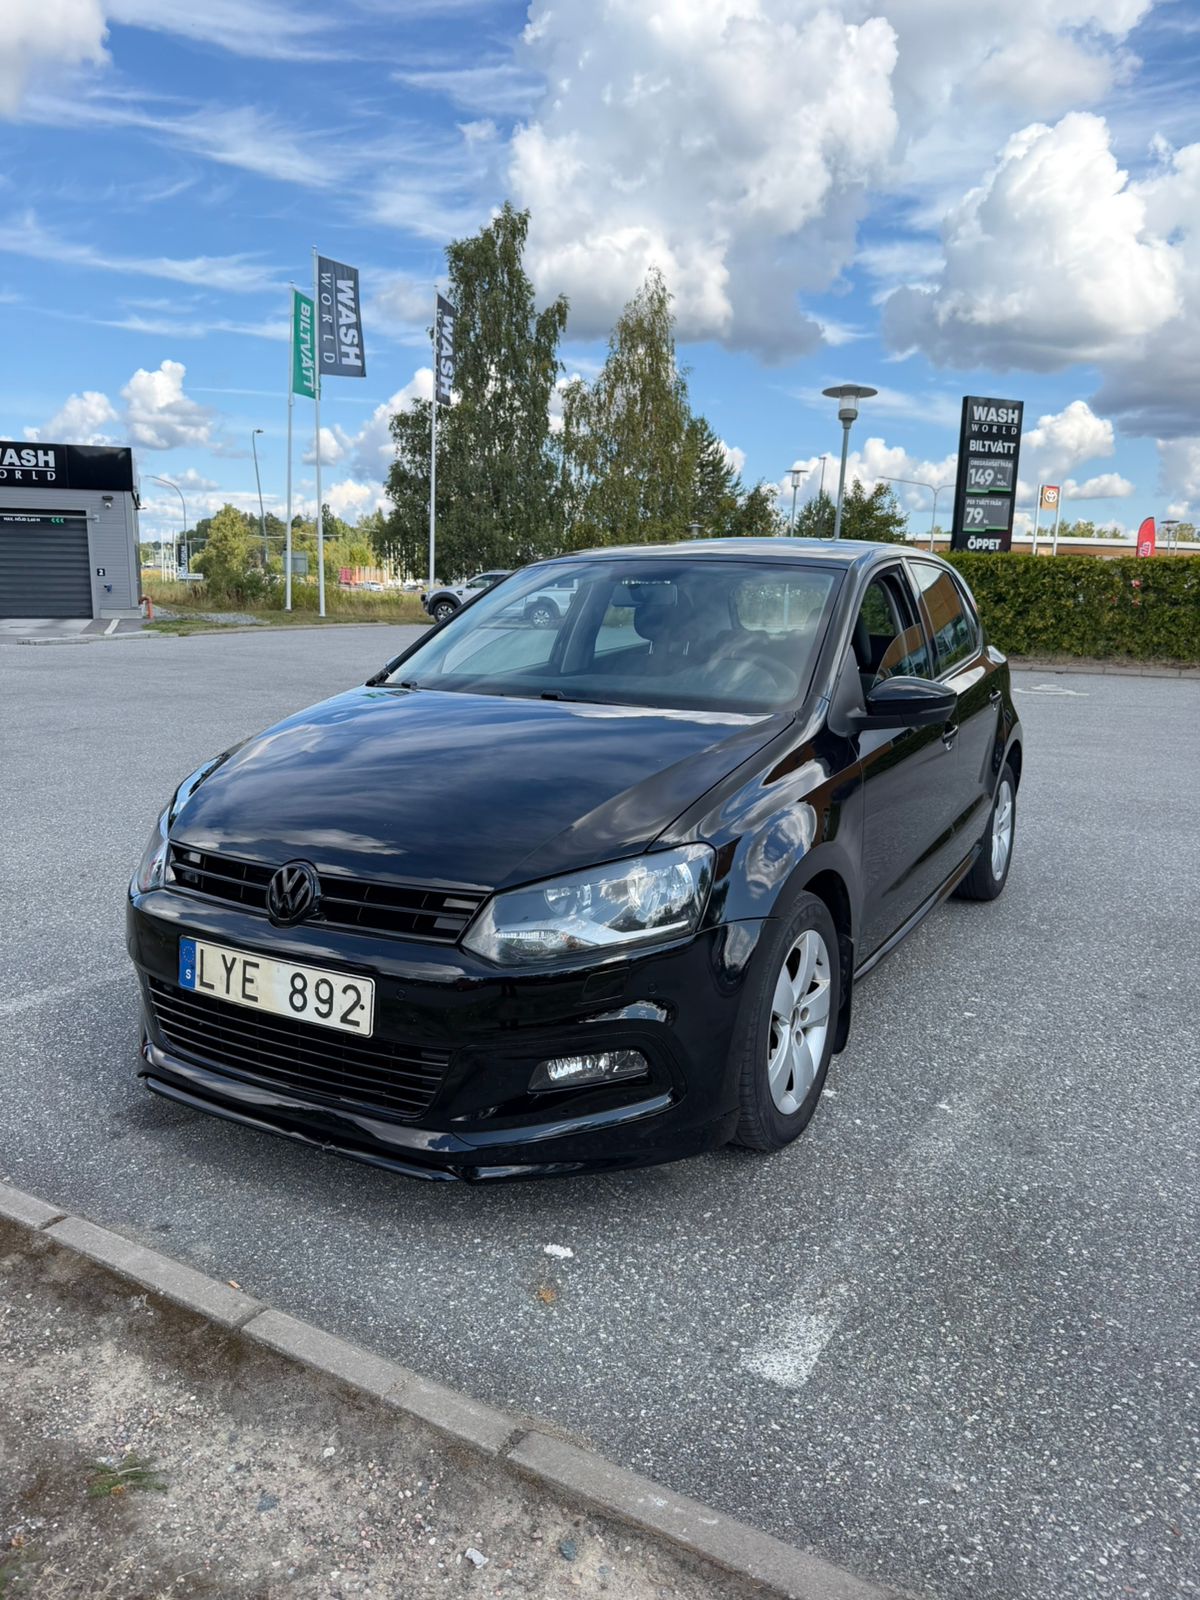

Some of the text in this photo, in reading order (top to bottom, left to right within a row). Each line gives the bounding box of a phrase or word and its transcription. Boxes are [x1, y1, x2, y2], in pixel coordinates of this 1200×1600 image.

[320, 272, 336, 364] WORLD
[336, 279, 362, 367] WASH
[300, 302, 314, 392] BILTVÄTT
[440, 315, 454, 396] WASH
[972, 405, 1019, 424] WASH
[971, 423, 1018, 435] WORLD
[969, 439, 1016, 454] BILTVÄTT
[0, 448, 56, 467] ASH
[0, 469, 56, 481] ORLD
[970, 468, 995, 485] 149
[966, 507, 984, 524] 79
[967, 536, 1001, 550] ÖPPET
[185, 969, 192, 980] S
[199, 948, 362, 1028] LYE 892
